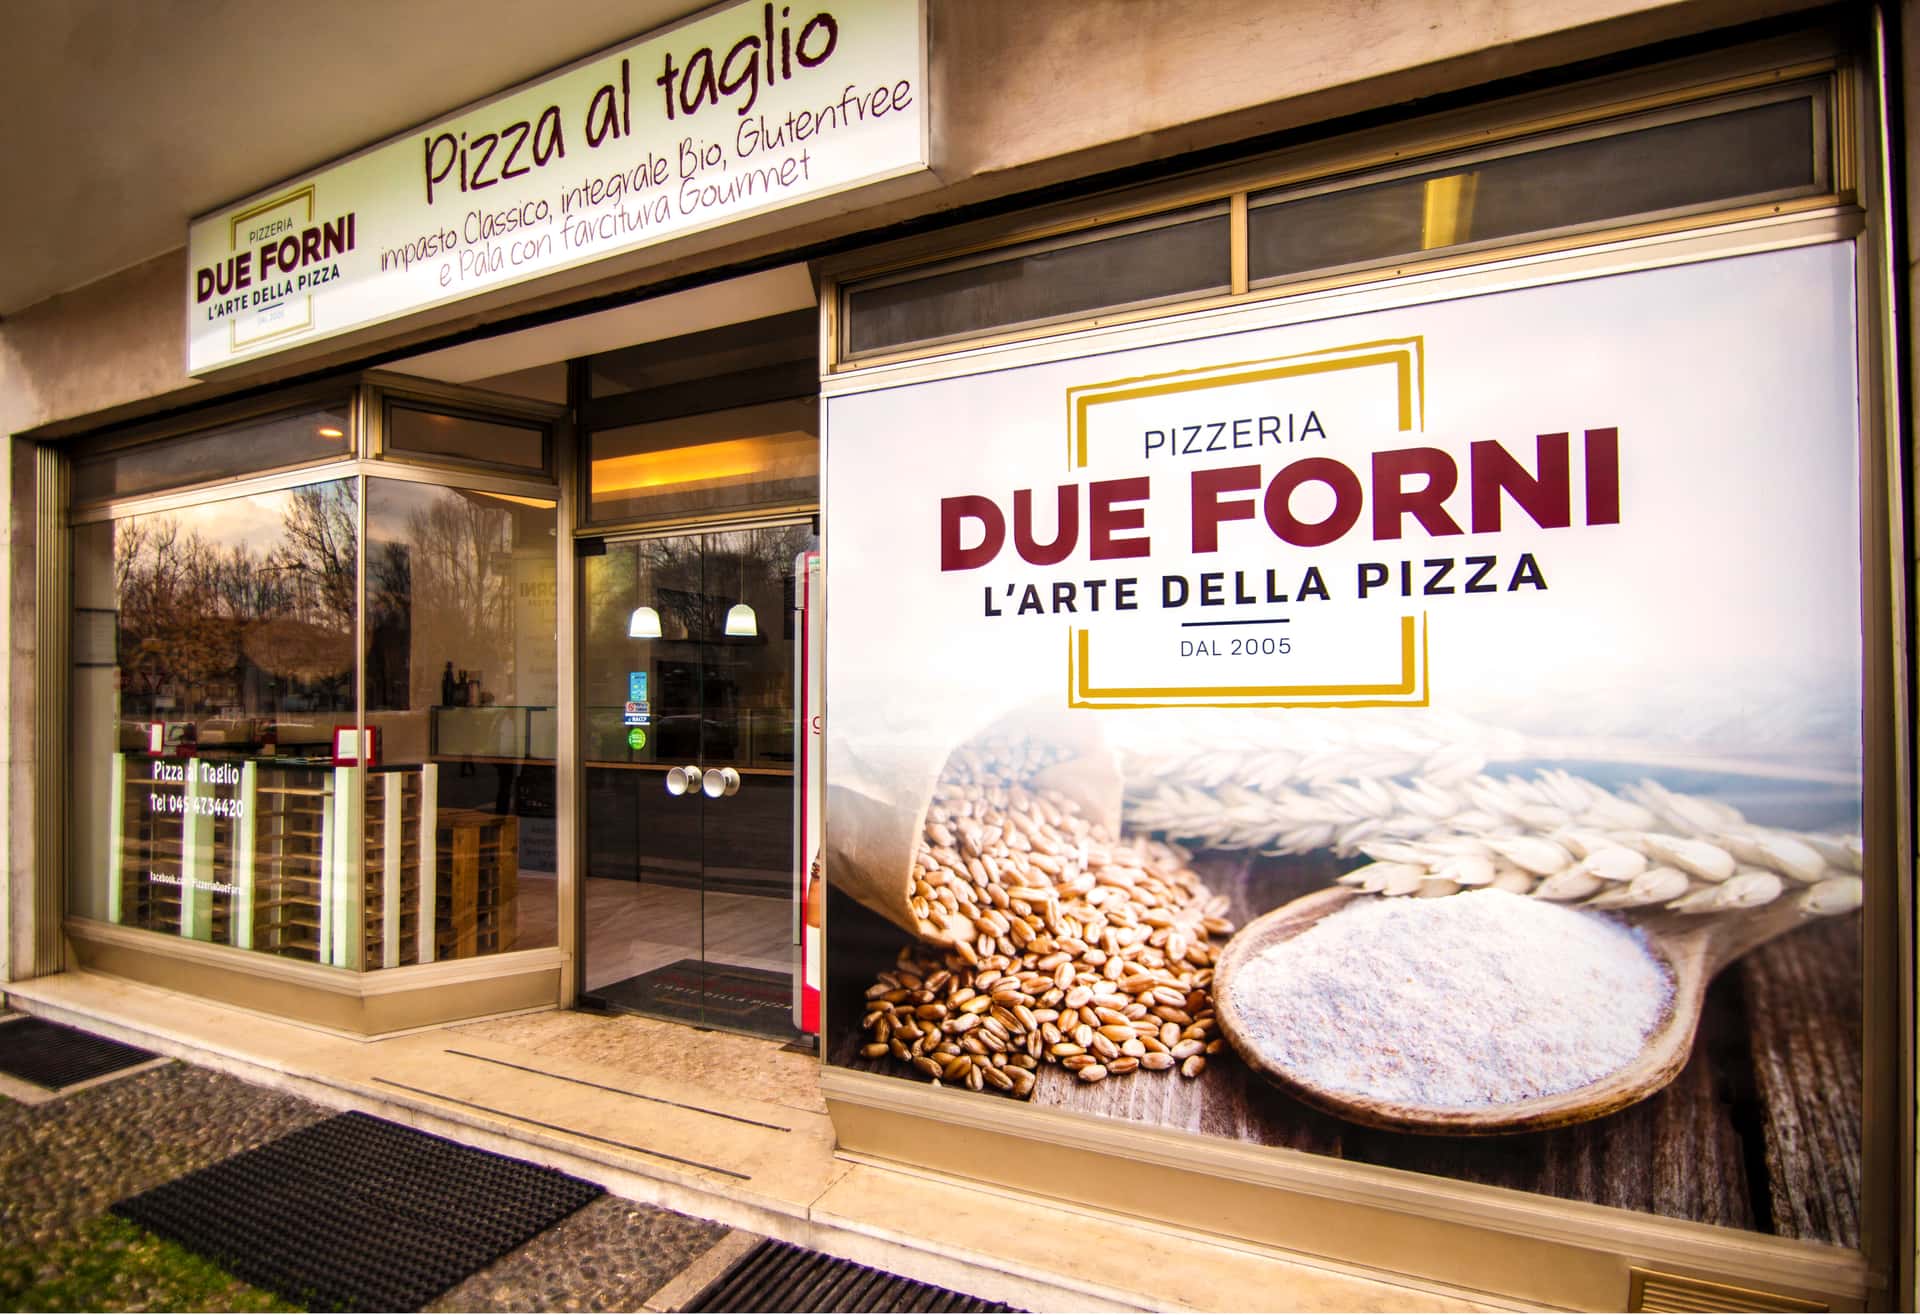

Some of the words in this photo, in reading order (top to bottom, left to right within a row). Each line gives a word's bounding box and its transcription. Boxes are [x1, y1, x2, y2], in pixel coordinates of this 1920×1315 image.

[423, 104, 565, 205] Pizza
[585, 58, 631, 148] al
[656, 2, 839, 120] taglio
[380, 227, 457, 273] impasto
[464, 199, 553, 245] Classico,
[561, 152, 670, 215] integrale
[679, 136, 727, 179] Bio,
[736, 79, 913, 158] Glutenfree
[249, 217, 294, 243] PIZZERIA
[439, 262, 451, 288] e
[458, 241, 504, 281] Pala
[510, 233, 552, 267] con
[559, 194, 671, 250] farcitura
[678, 148, 811, 216] Gourmet
[197, 251, 252, 304] DUE
[260, 212, 356, 281] FORNI
[208, 294, 249, 320] L'ARTE
[252, 279, 293, 306] DELLA
[298, 263, 340, 290] PIZZA
[1143, 410, 1327, 459] PIZZERIA
[940, 475, 1151, 572] DUE
[1190, 425, 1621, 555] FORNI
[983, 577, 1138, 617] L'ARTE
[1161, 565, 1331, 609] DELLA
[1356, 551, 1548, 599] PIZZA
[1180, 639, 1223, 658] DAL
[1230, 636, 1293, 657] 2005
[153, 760, 184, 781] Pizza
[201, 762, 240, 784] Taglio
[150, 793, 167, 812] Tel
[169, 794, 189, 813] 045
